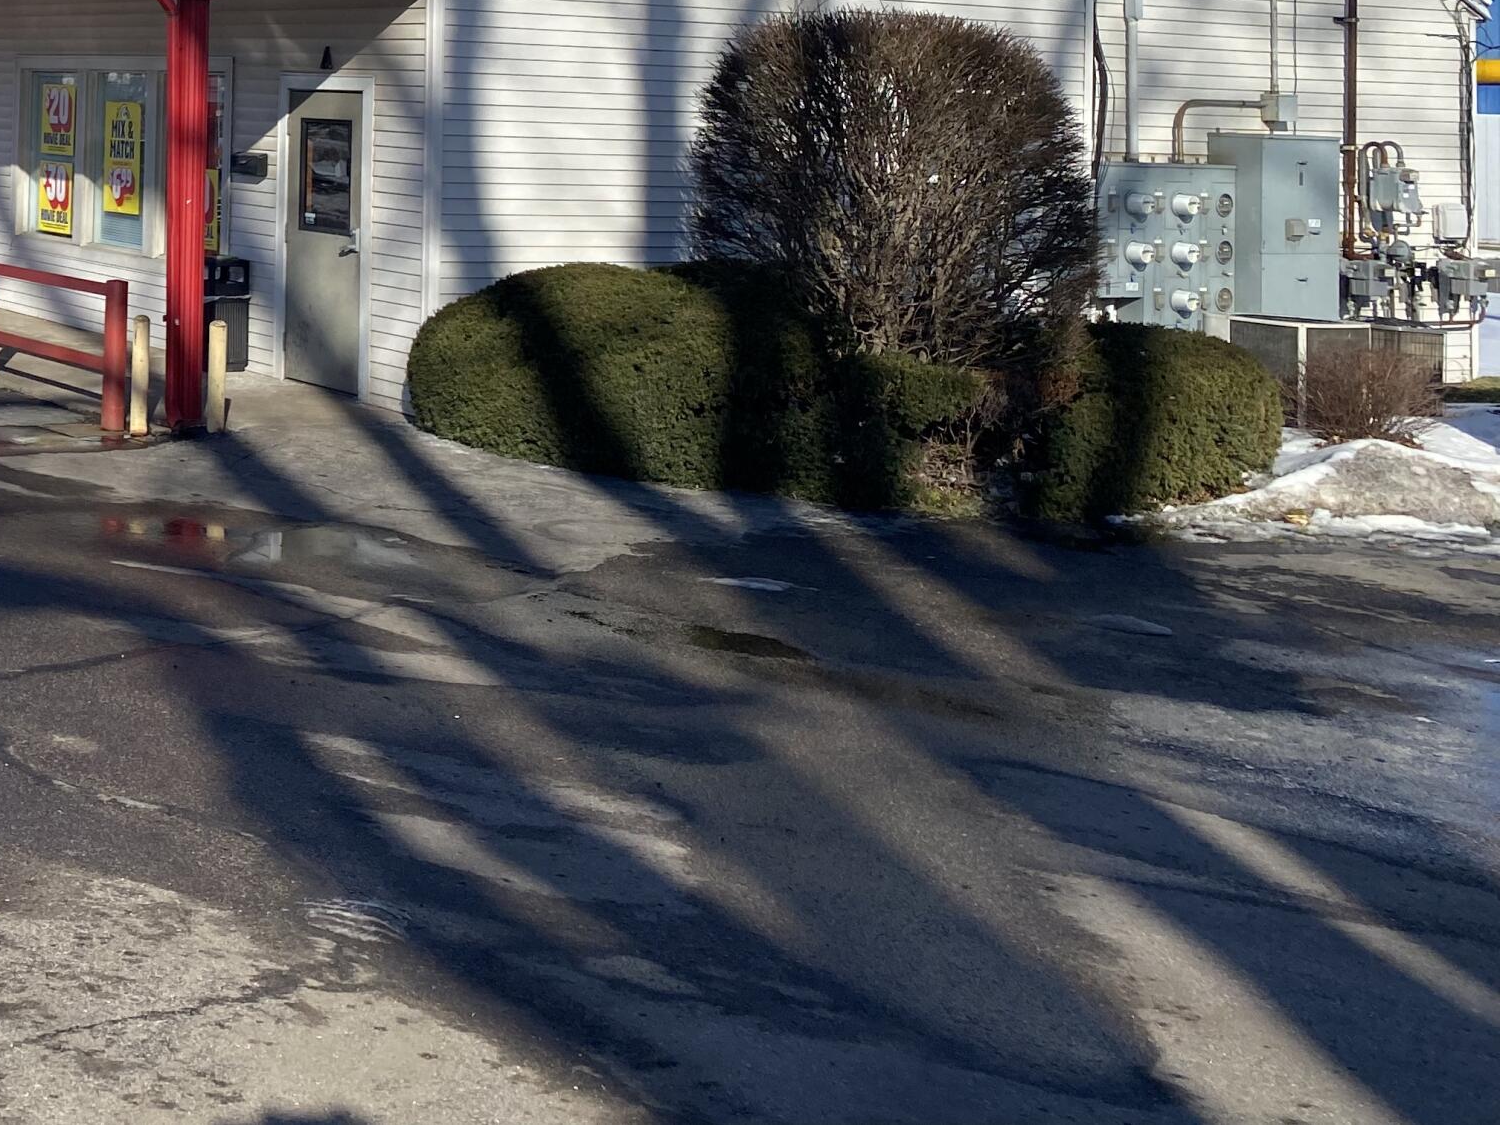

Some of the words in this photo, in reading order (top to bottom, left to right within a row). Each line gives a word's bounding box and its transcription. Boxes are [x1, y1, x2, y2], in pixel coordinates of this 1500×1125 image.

[45, 87, 70, 124] $20
[111, 119, 126, 139] MIX
[128, 121, 134, 139] &
[110, 139, 135, 160] MATCH
[43, 164, 67, 203] $30
